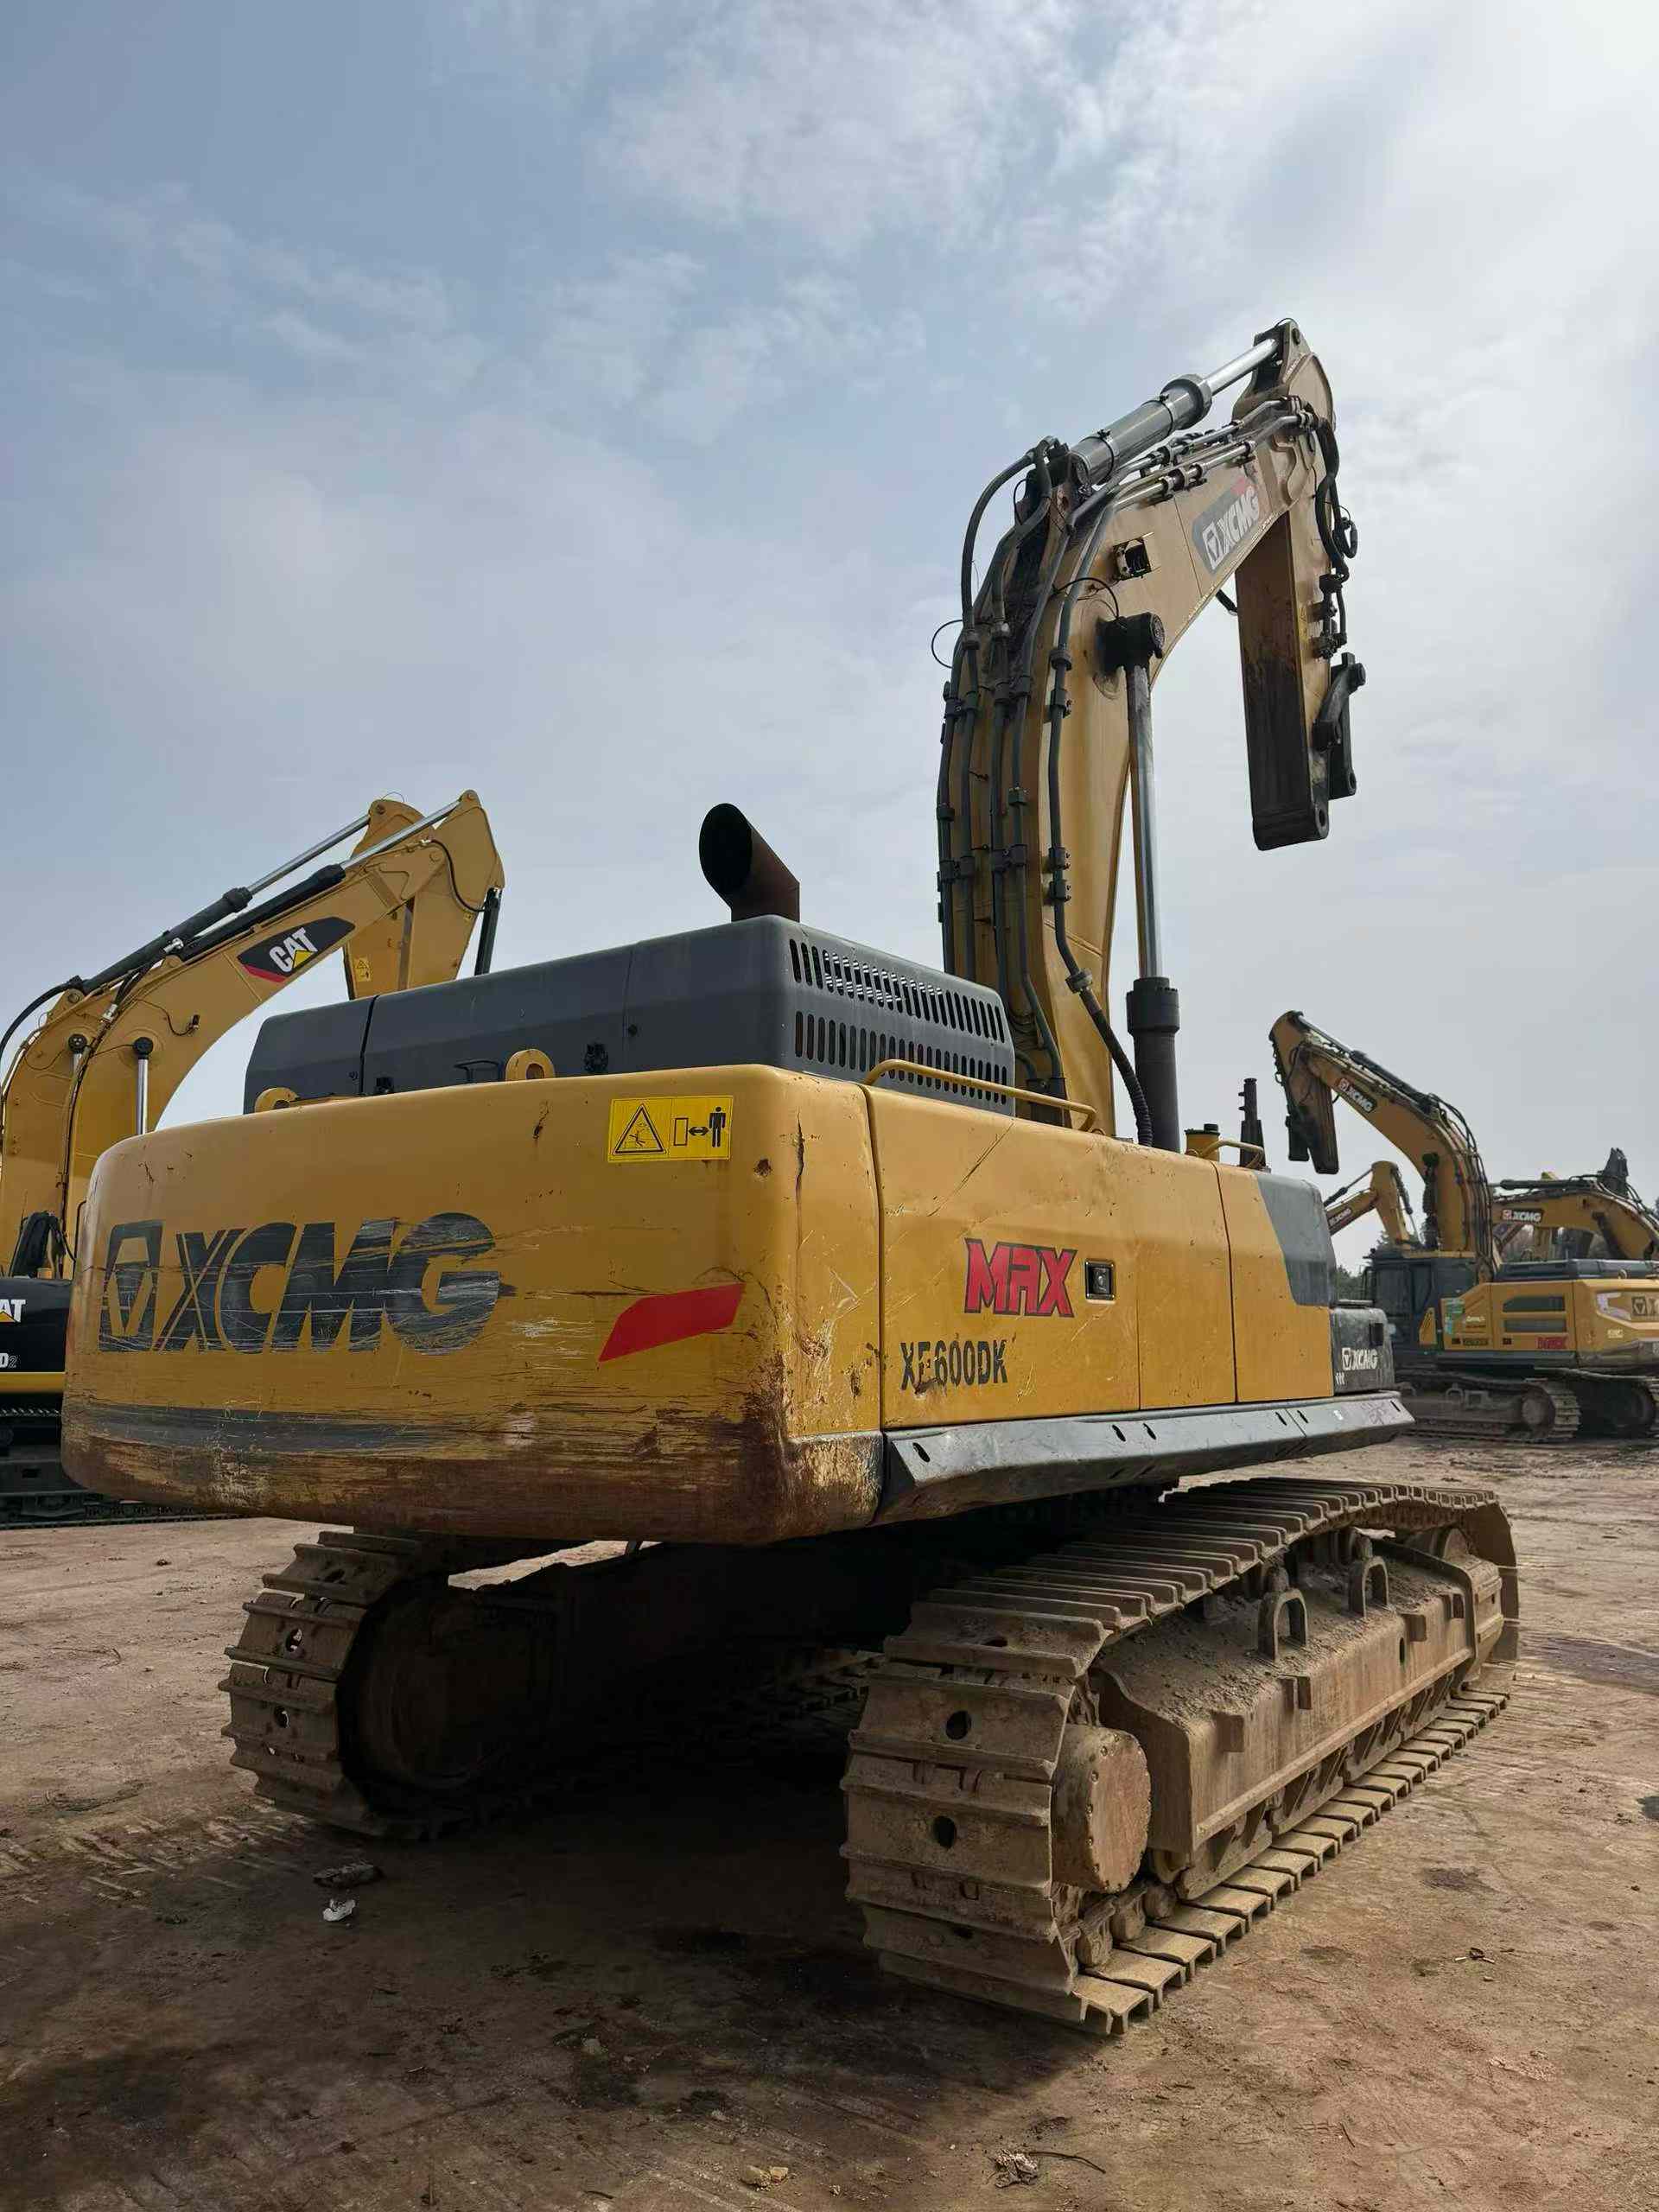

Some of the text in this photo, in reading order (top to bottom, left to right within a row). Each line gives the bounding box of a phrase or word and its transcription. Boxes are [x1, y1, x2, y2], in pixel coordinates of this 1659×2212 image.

[1217, 486, 1259, 554] XCMG
[270, 927, 318, 972] CAT
[1348, 1085, 1373, 1112] XCMG
[1513, 1211, 1541, 1222] XCMG
[153, 1212, 501, 1355] XCMG
[964, 1237, 1078, 1318] MAX
[1352, 1349, 1378, 1370] XCMG
